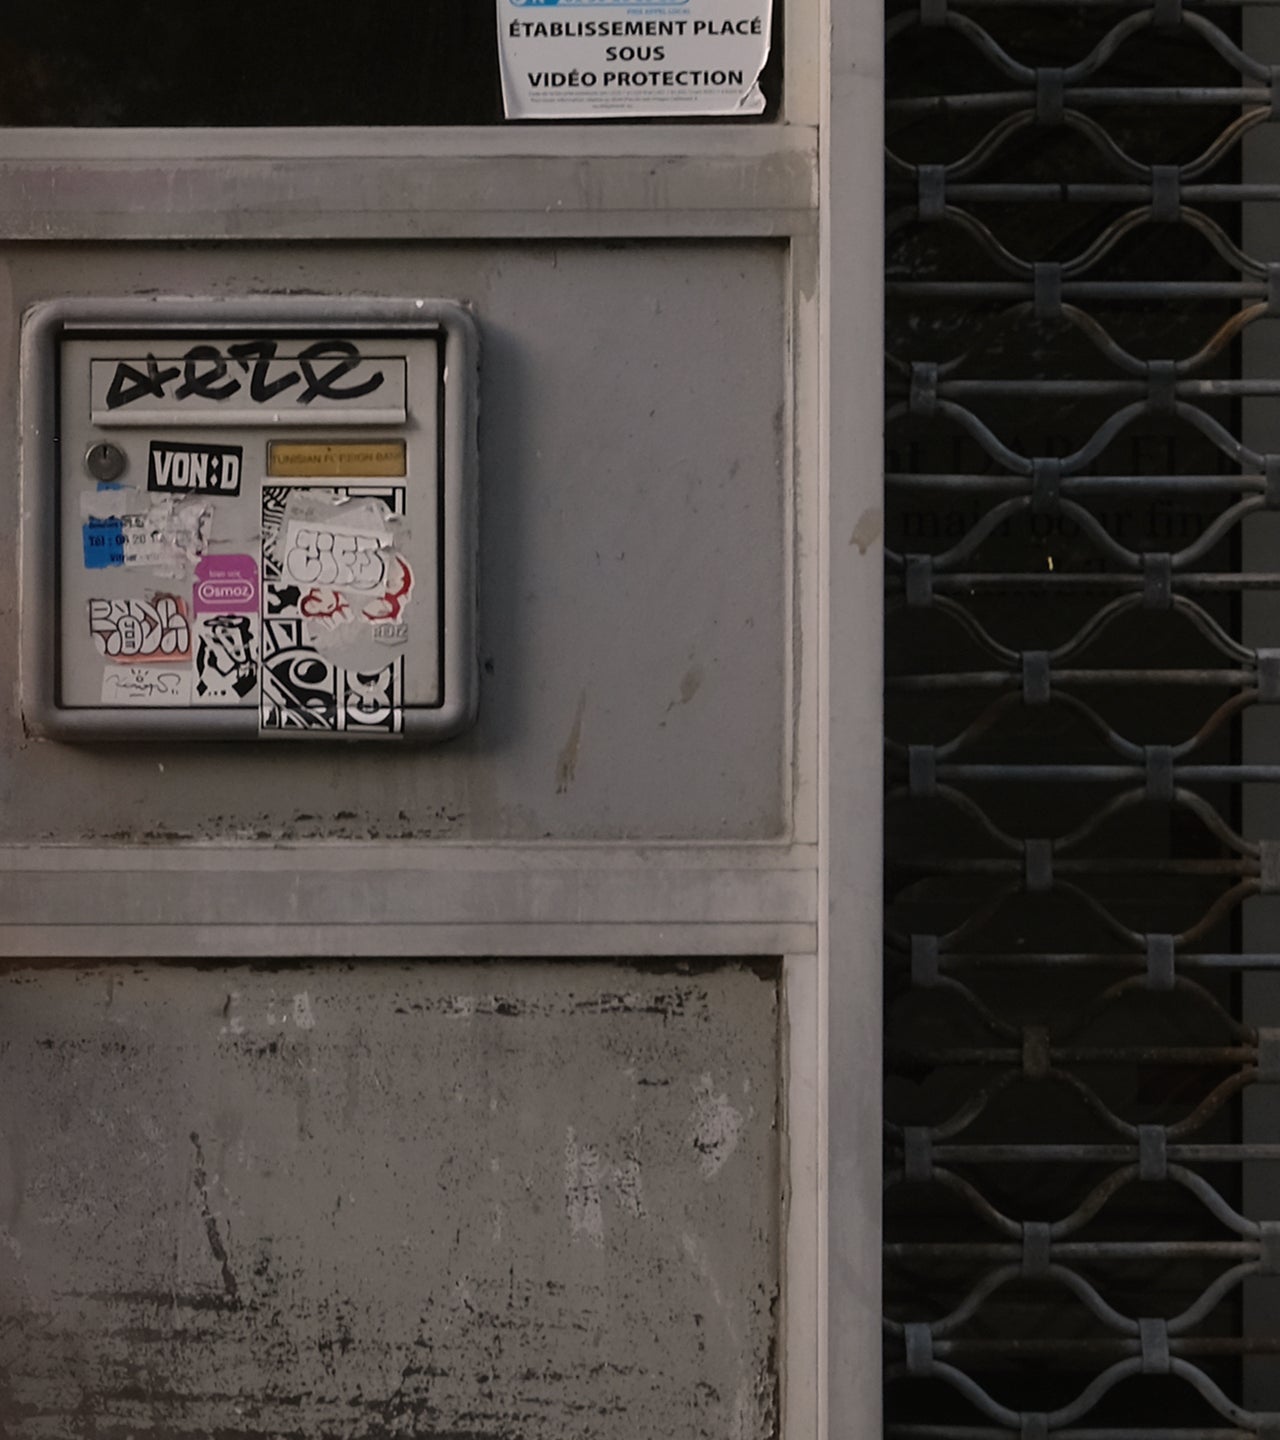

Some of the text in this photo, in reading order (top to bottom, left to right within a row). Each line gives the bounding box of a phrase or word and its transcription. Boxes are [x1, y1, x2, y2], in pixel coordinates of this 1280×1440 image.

[509, 16, 762, 38] ÉTABLISSEMENT PLACÉ
[606, 46, 665, 62] SOUS
[527, 68, 744, 87] VIDÉO PROTECTION
[202, 585, 251, 598] Osmoz
